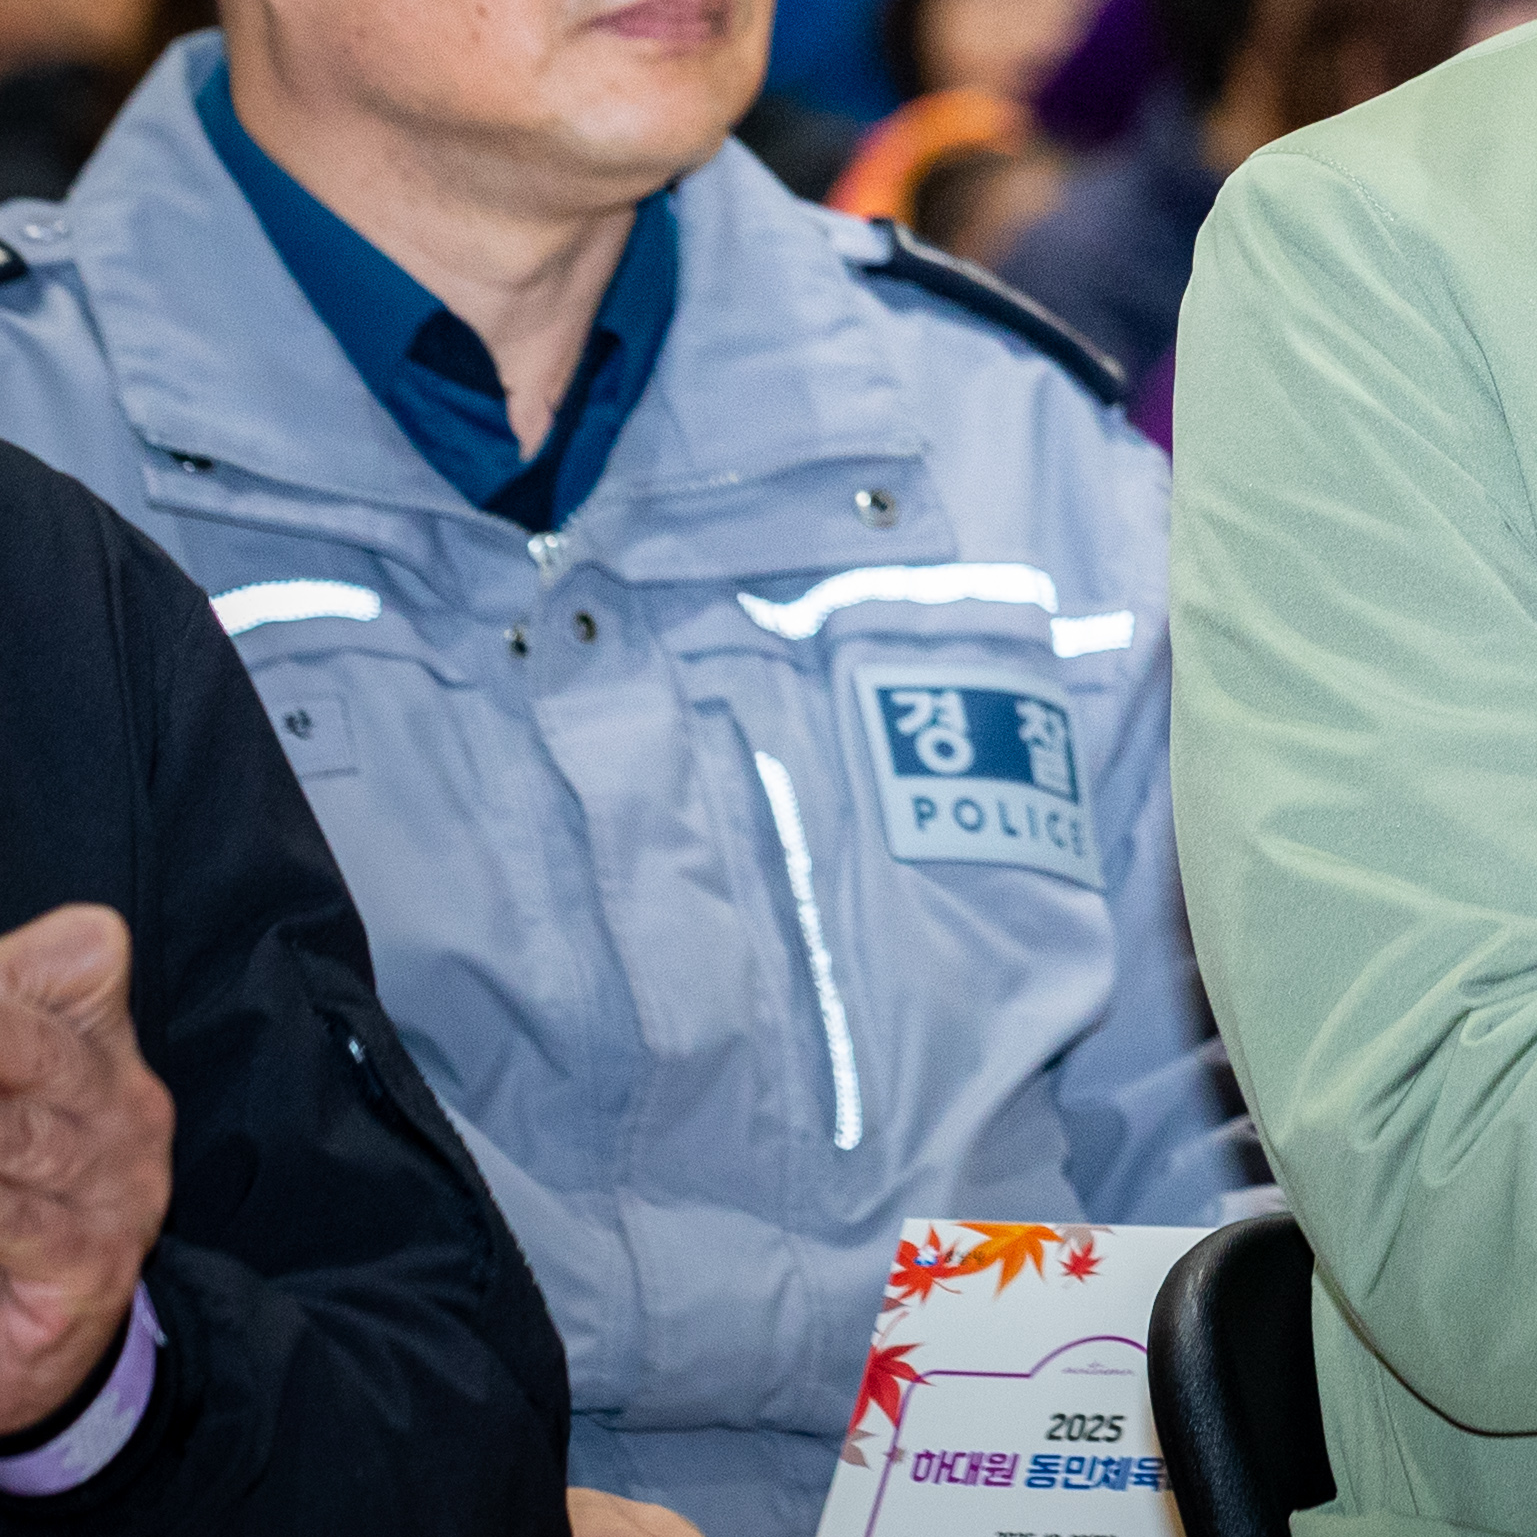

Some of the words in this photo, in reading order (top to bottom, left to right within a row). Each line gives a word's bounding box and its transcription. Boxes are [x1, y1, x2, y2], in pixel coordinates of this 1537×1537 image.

[888, 689, 1074, 798] 경찰
[911, 794, 1086, 858] POLICE
[1046, 1413, 1126, 1443] 2025
[910, 1449, 1020, 1488] 하대원
